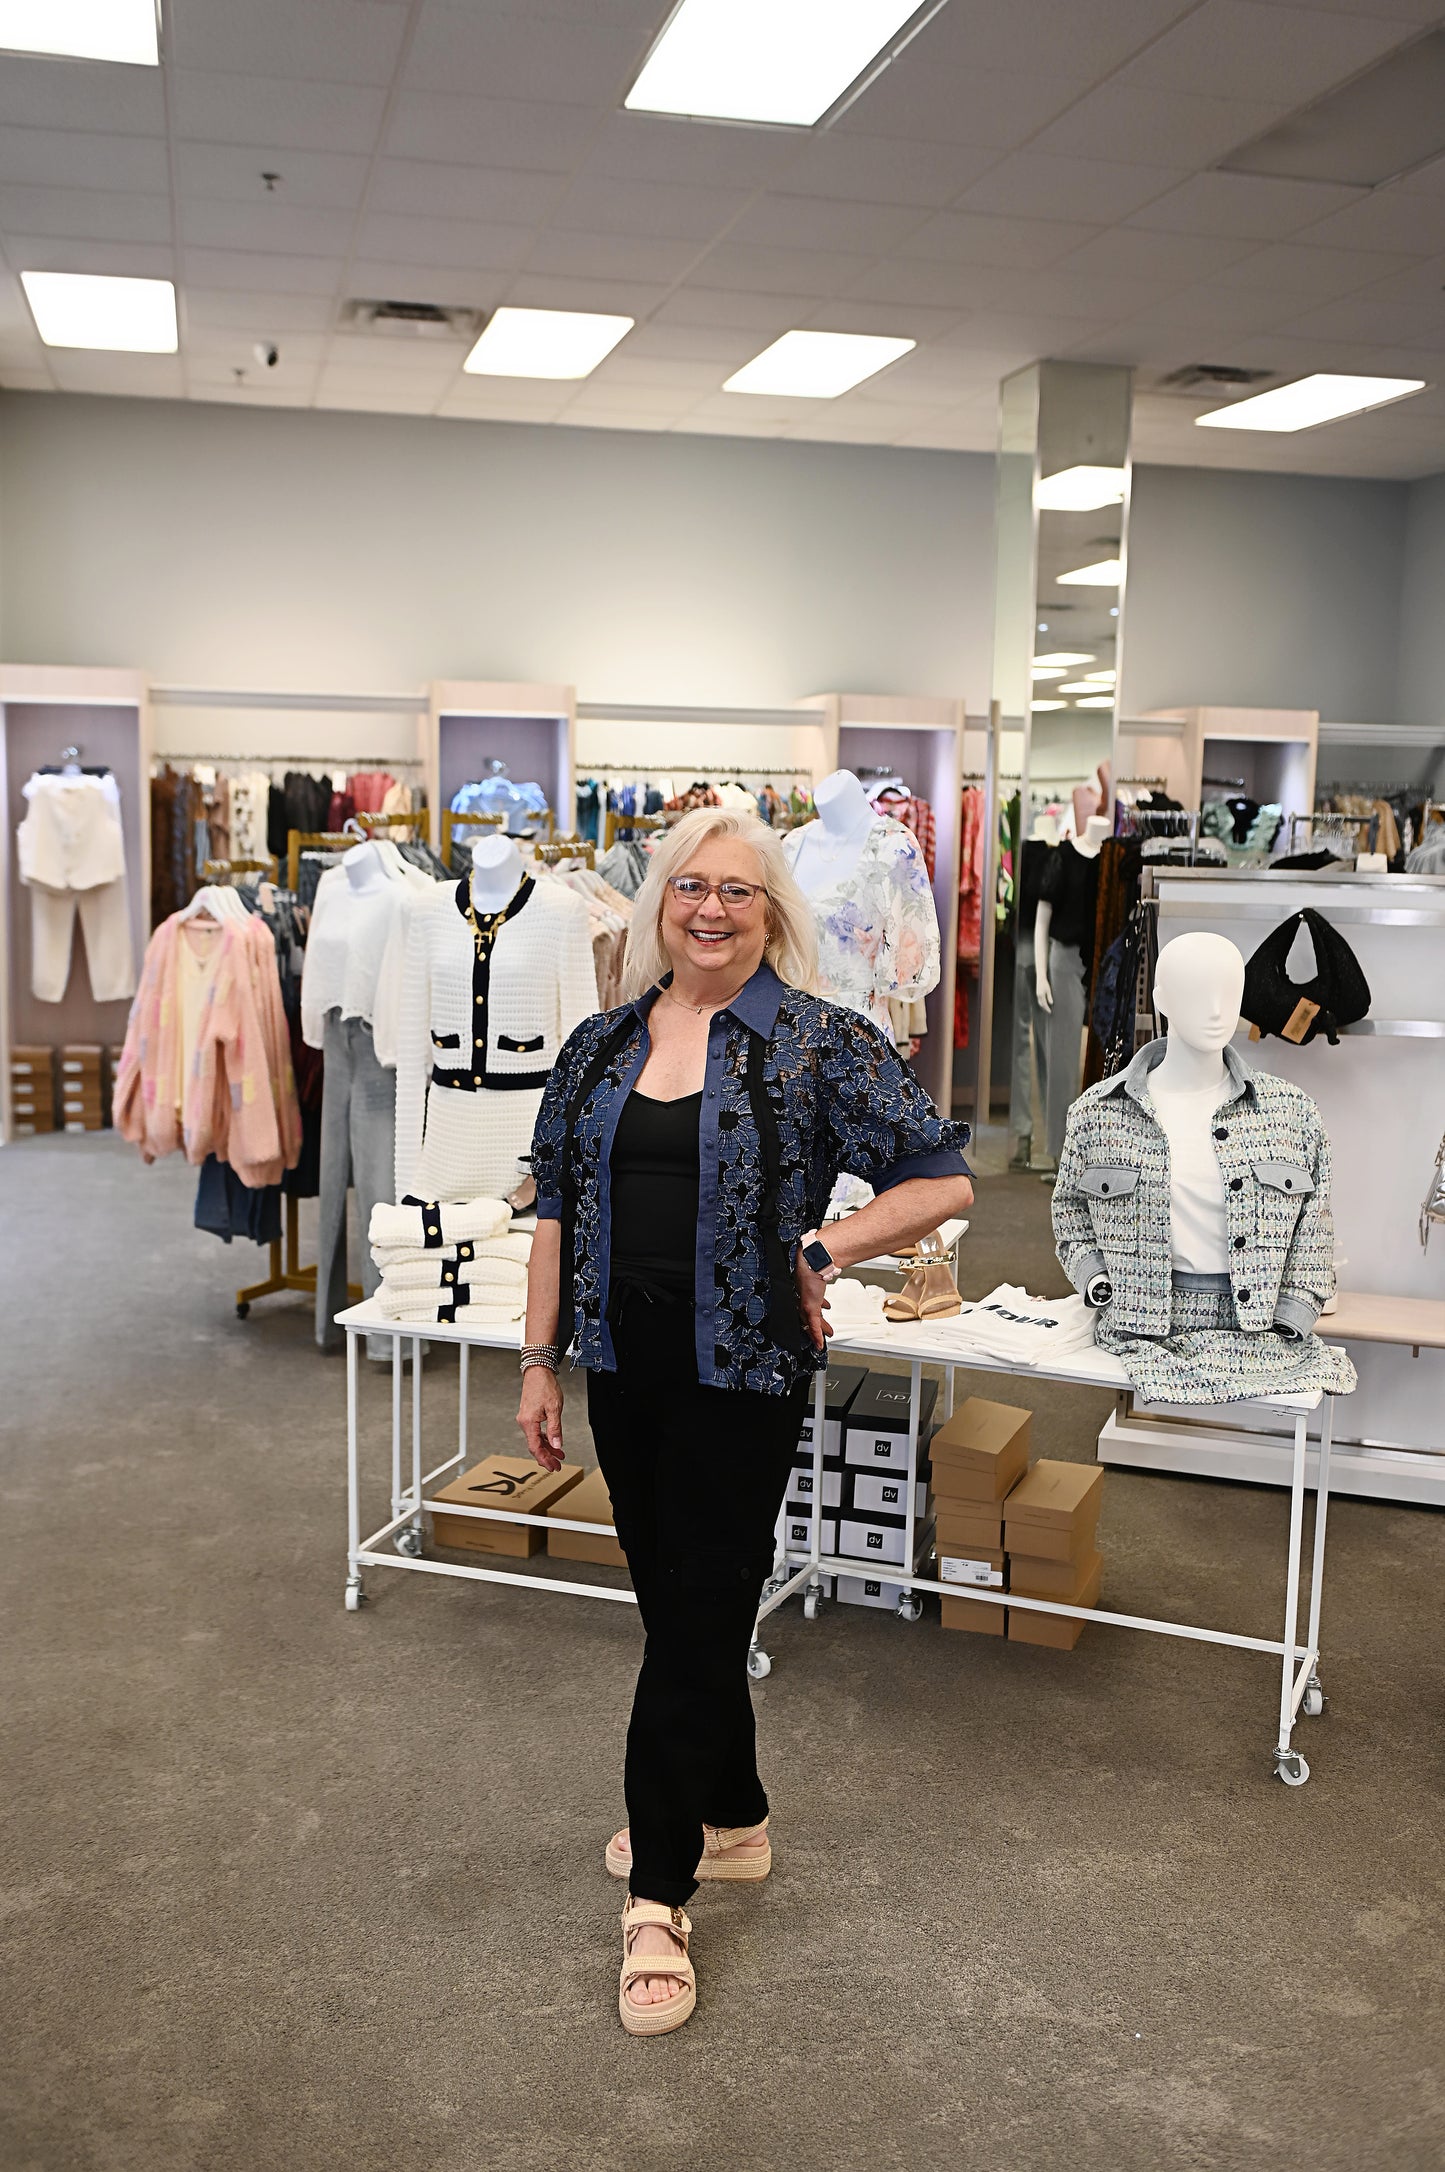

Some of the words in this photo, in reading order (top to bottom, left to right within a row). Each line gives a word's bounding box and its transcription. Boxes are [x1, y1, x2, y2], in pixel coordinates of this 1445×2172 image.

[877, 1444, 889, 1452] dv
[884, 1490, 896, 1498] dv
[869, 1536, 881, 1544] dv
[866, 1583, 879, 1592] dv
